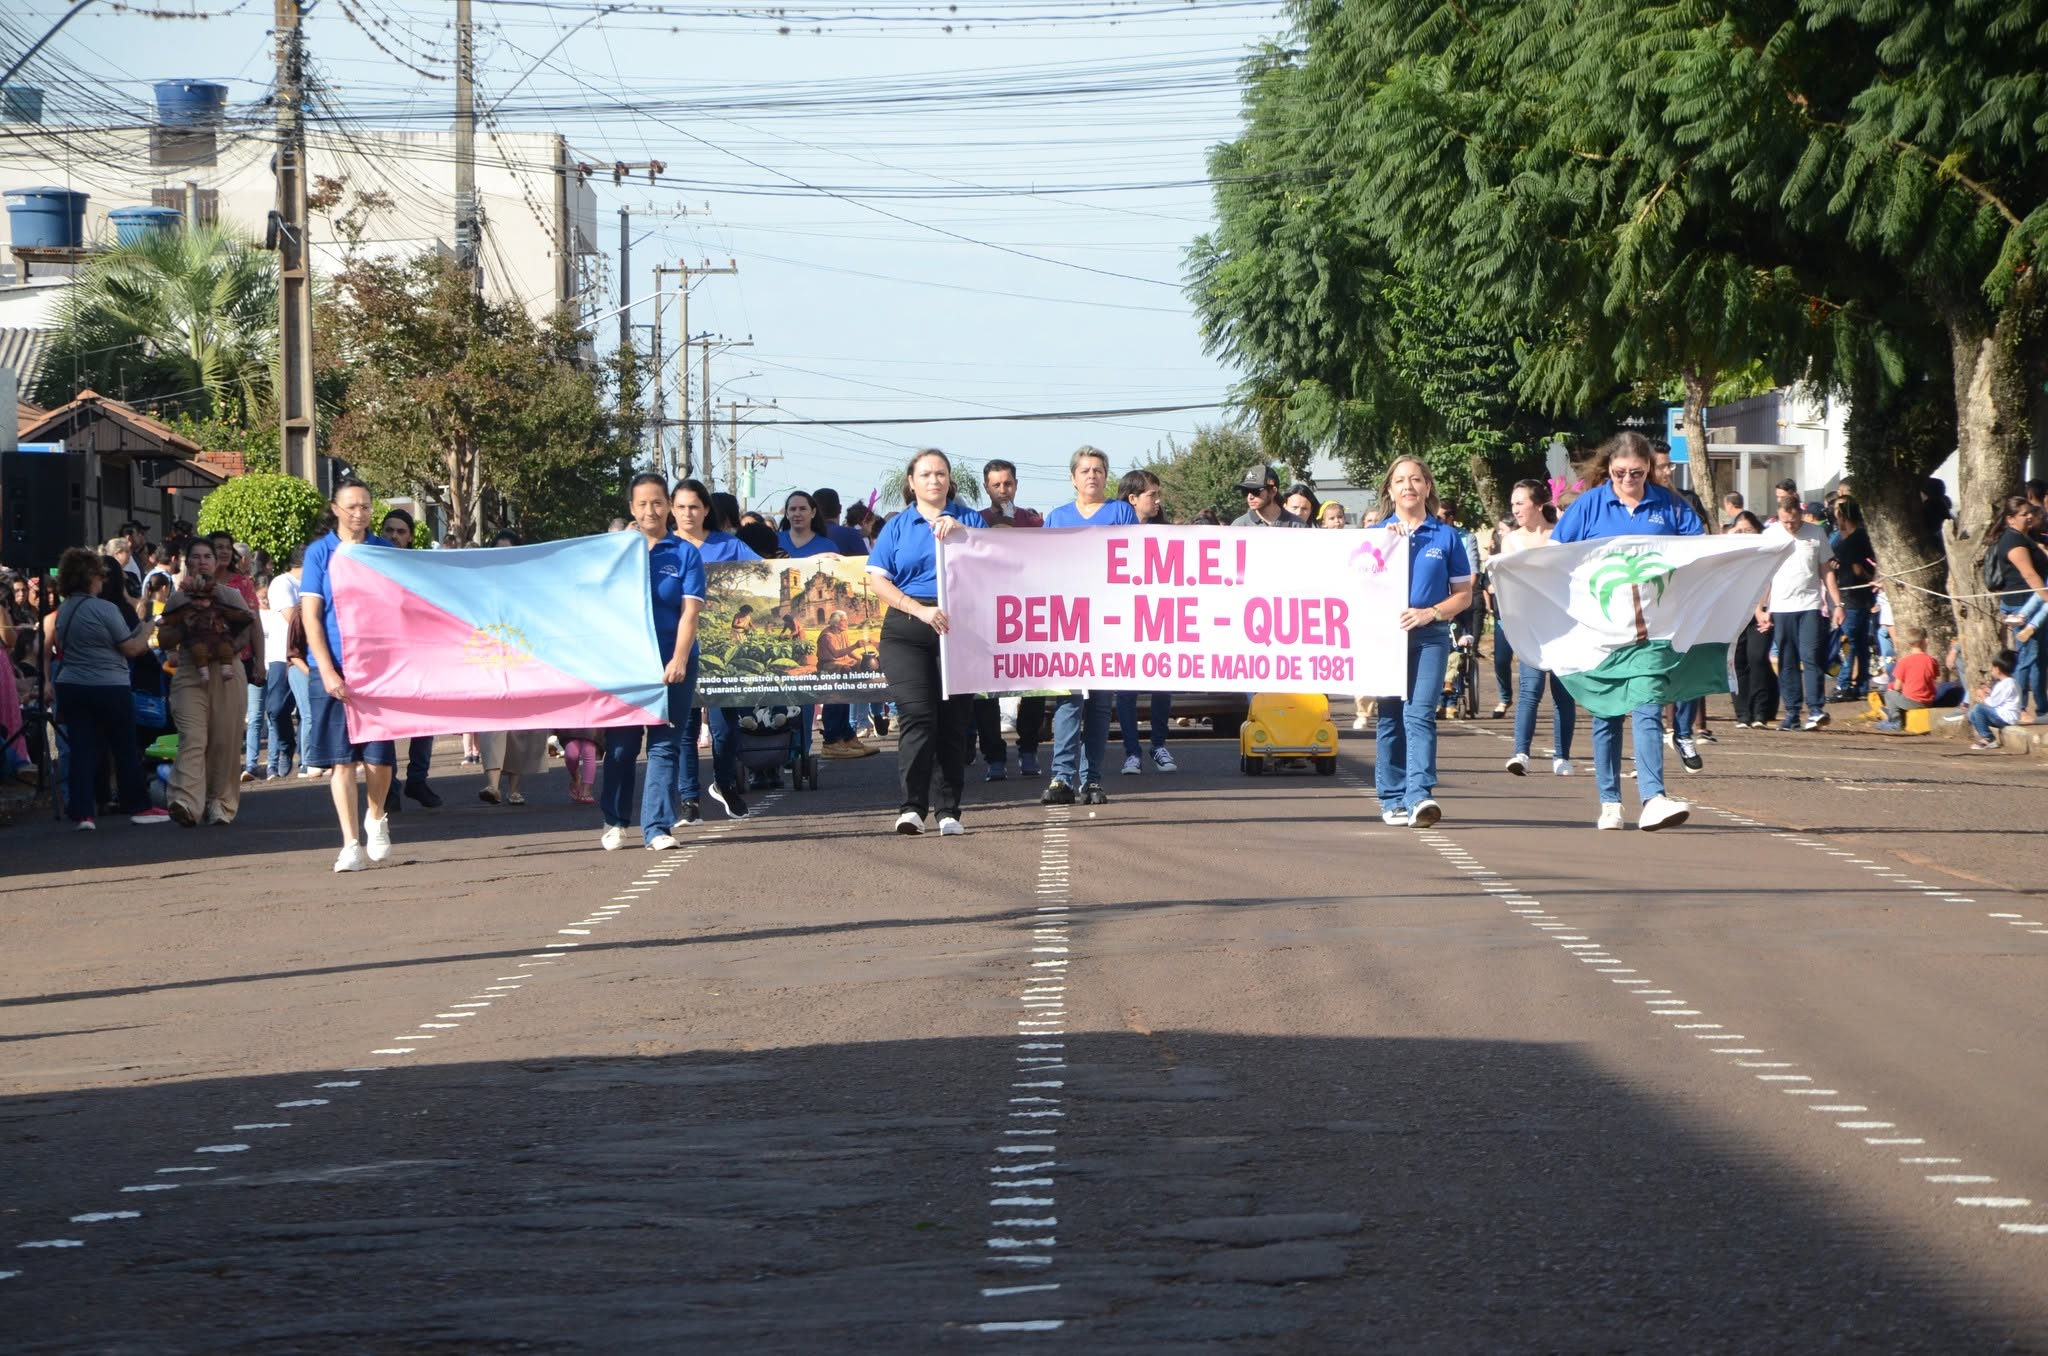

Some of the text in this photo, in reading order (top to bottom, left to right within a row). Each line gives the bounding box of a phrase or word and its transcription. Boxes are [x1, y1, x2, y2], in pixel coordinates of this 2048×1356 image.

[996, 595, 1090, 643] BEM
[1134, 595, 1200, 644] ME
[1243, 597, 1350, 649] QUER
[723, 676, 738, 684] que
[820, 672, 841, 680] onde
[849, 670, 880, 680] história
[993, 652, 1354, 681] FUNDADA EM 06 DE MAIO DE 1981
[706, 685, 742, 695] guaranis
[743, 684, 779, 693] continua
[780, 684, 797, 692] viva
[813, 682, 833, 691] cada
[833, 681, 855, 690] folha
[856, 681, 867, 689] de
